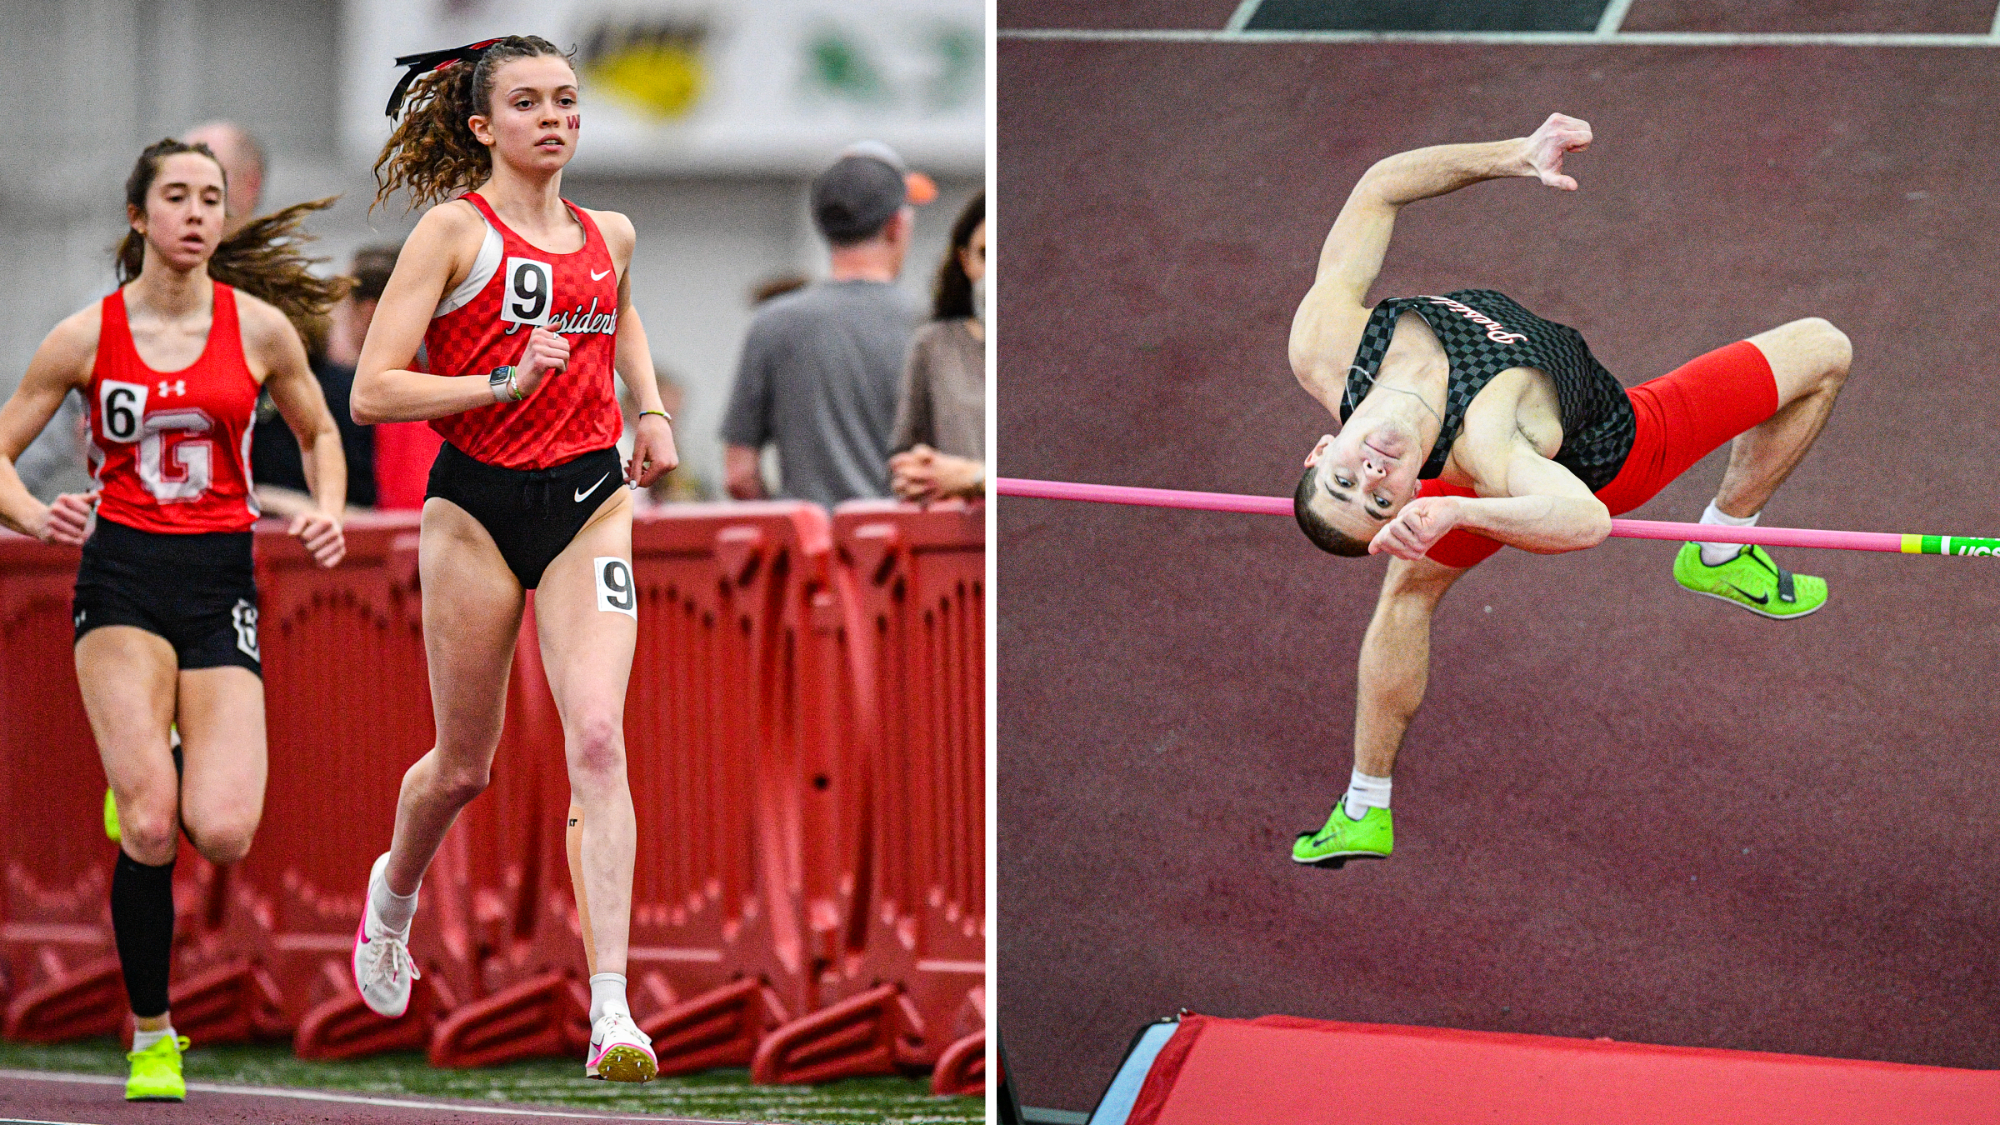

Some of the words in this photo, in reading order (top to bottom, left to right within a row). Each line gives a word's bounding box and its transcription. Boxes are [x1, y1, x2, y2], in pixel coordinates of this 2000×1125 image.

[511, 262, 547, 320] 9
[106, 387, 136, 438] 6
[135, 407, 215, 505] G
[603, 560, 634, 611] 9
